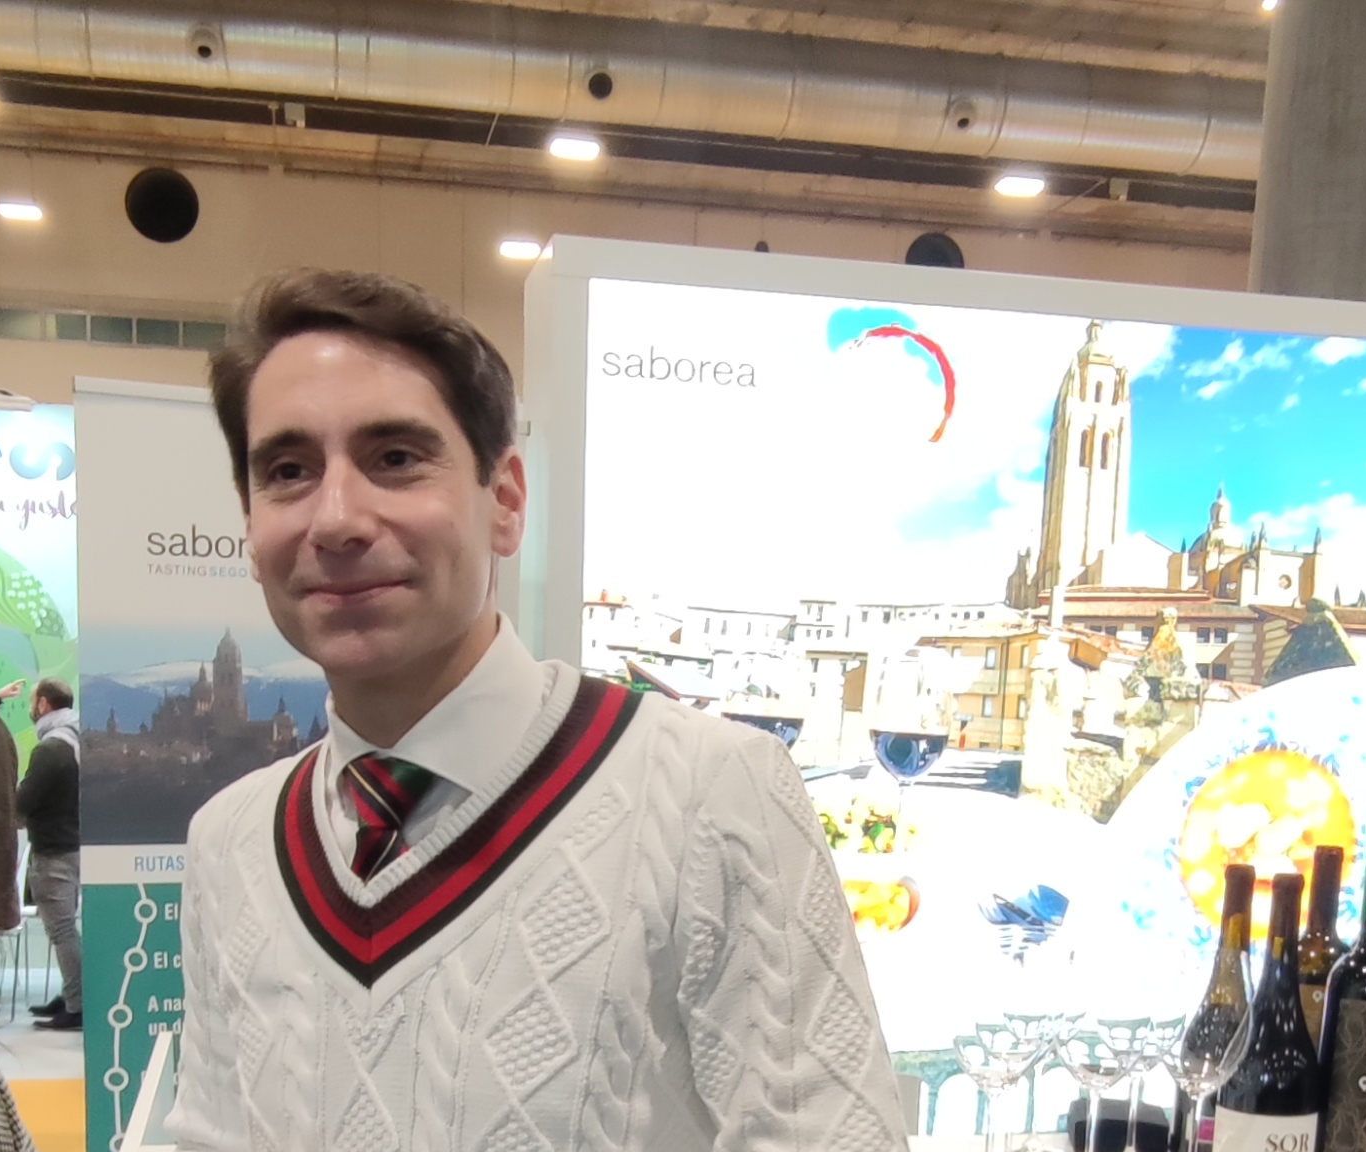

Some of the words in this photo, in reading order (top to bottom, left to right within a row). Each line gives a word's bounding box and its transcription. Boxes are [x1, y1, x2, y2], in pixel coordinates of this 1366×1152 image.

[602, 345, 757, 388] saborea
[135, 856, 185, 872] RUTAS
[153, 951, 168, 969] El
[147, 995, 160, 1013] A
